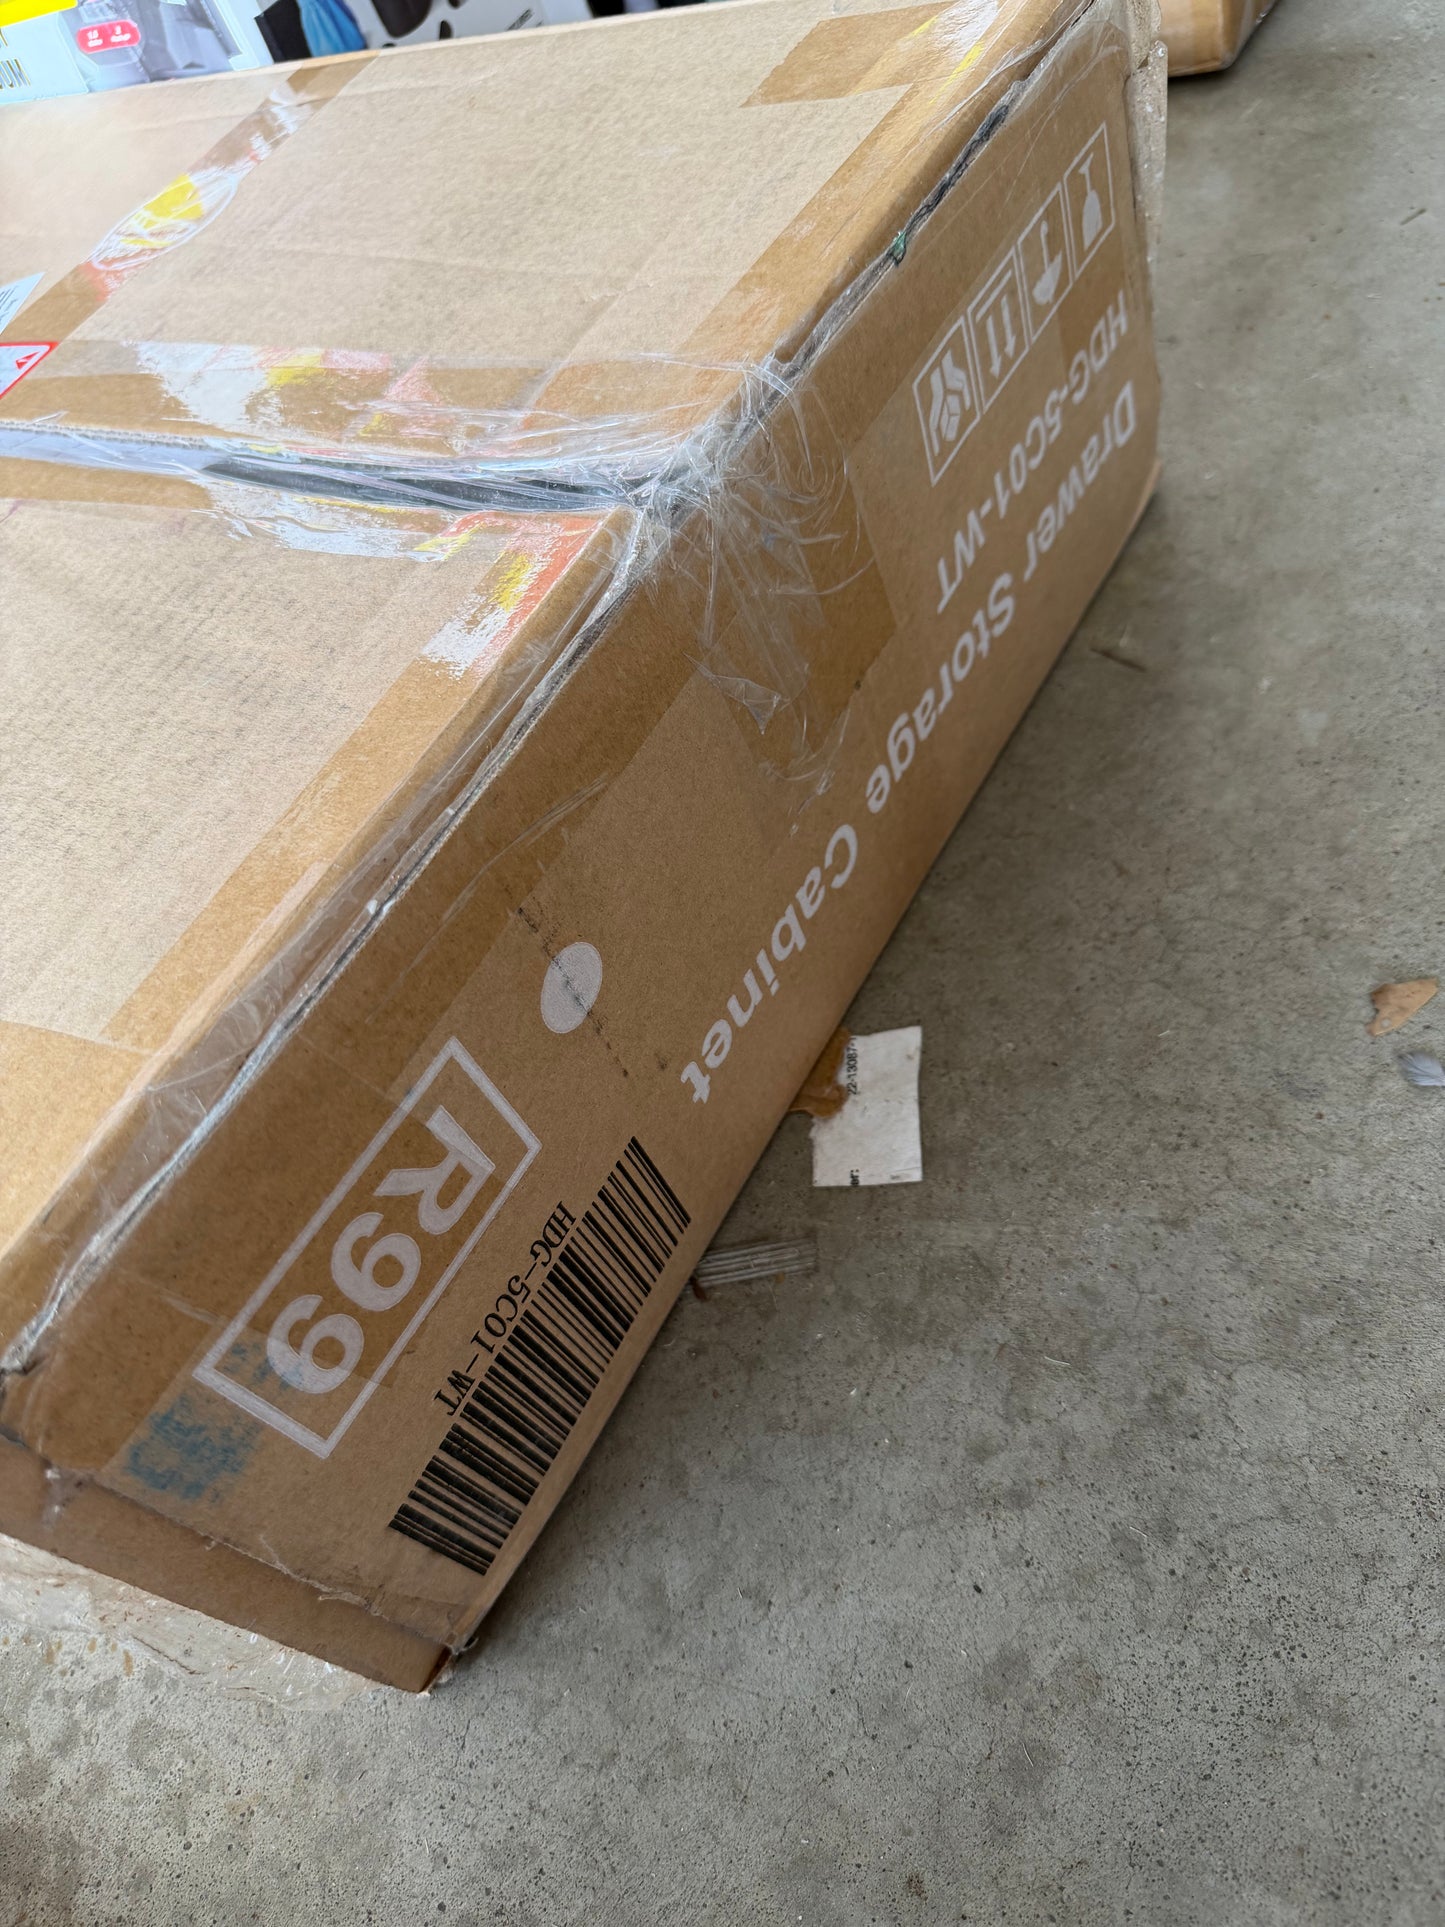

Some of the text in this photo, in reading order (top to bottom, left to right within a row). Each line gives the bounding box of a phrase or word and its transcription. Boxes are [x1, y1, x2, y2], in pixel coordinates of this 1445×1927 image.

[935, 289, 1129, 614] HDG-5C01-WT
[680, 380, 1138, 1105] Drawer Storage Cabinet
[266, 1105, 496, 1394] R99
[433, 1201, 577, 1416] HDG-5C01-WT
